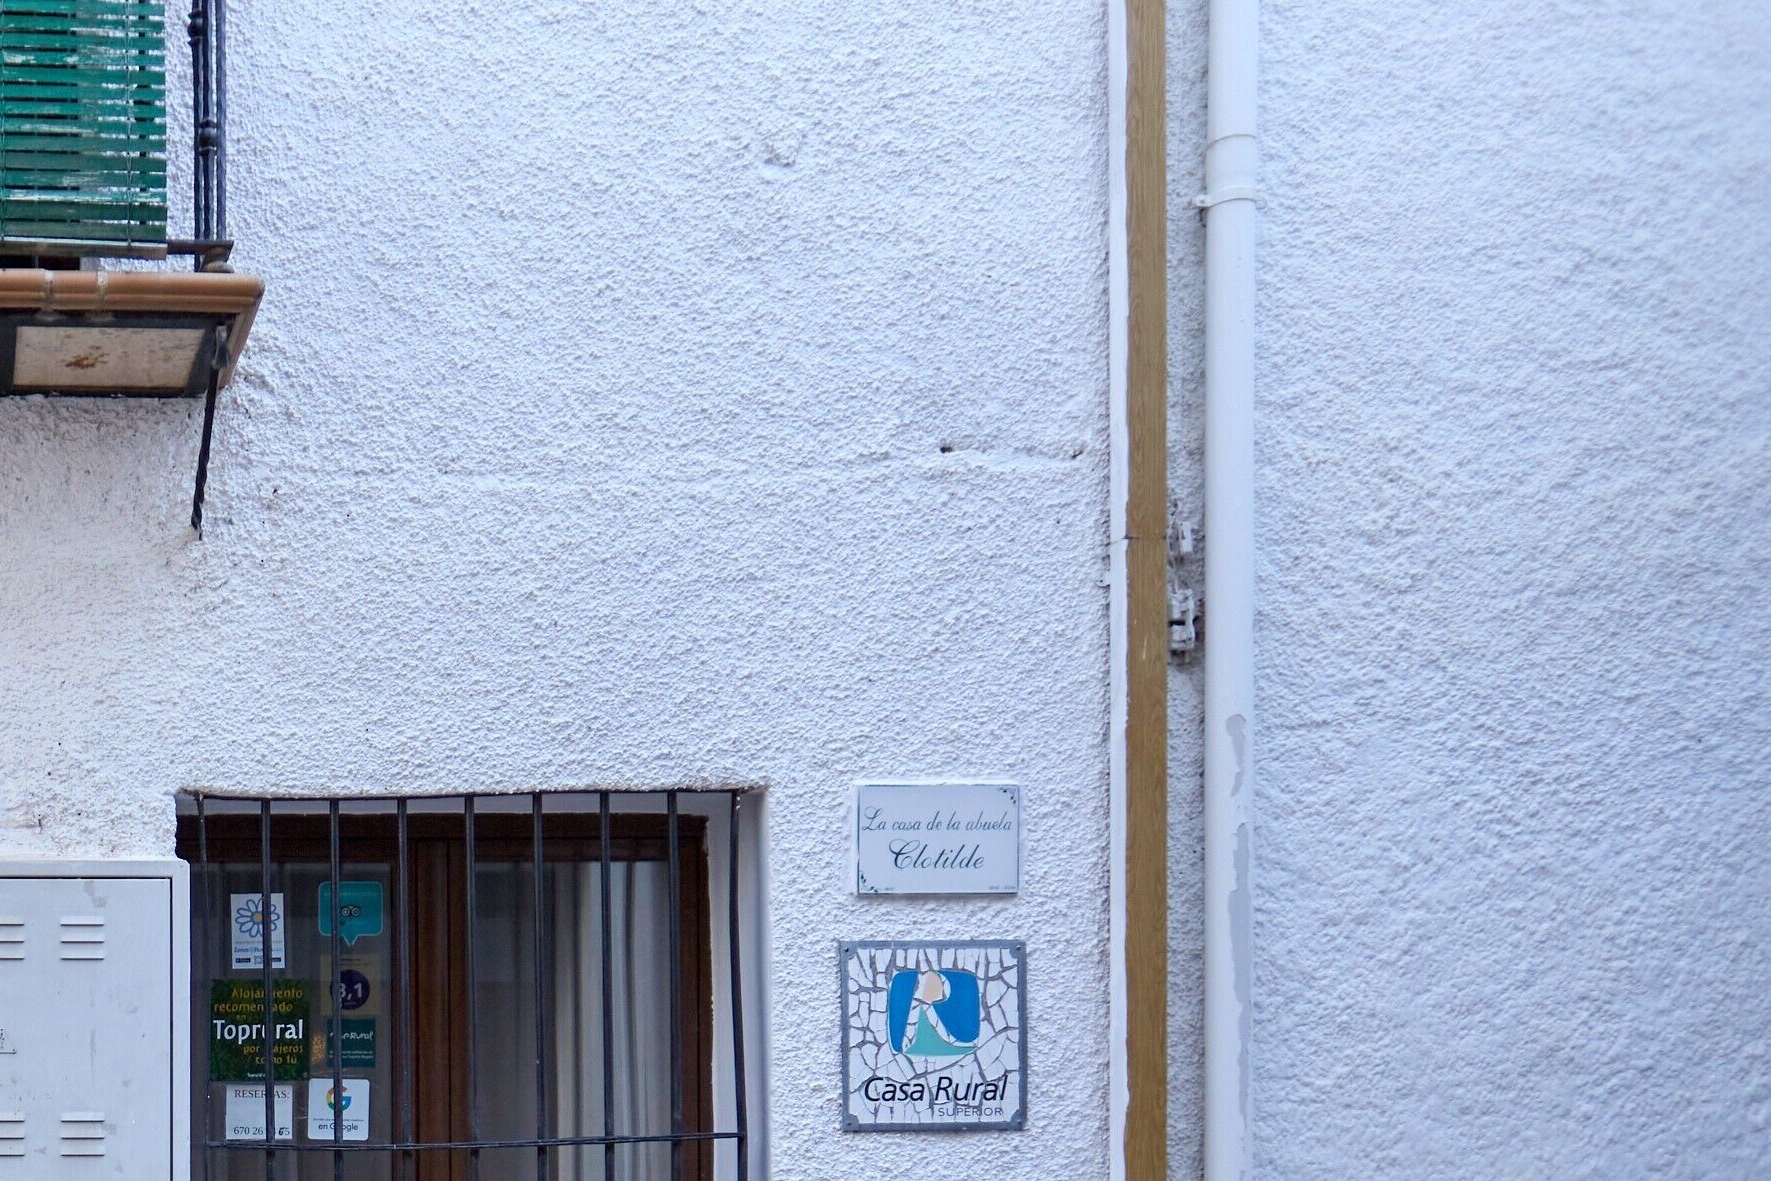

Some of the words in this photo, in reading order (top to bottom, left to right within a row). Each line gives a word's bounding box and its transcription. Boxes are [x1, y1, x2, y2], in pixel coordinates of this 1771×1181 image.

[862, 806, 886, 831] La
[891, 821, 921, 831] casa
[926, 810, 943, 831] de
[946, 810, 961, 831] la
[965, 810, 1012, 831] abuela
[888, 838, 985, 870] Clotilde
[213, 1002, 293, 1013] recomenado
[269, 1045, 304, 1055] ajeros
[864, 1077, 925, 1102] Casa
[934, 1074, 1008, 1102] Rural
[234, 1089, 290, 1100] RESERAS:
[938, 1107, 1003, 1117] SUPERIOR
[233, 1126, 250, 1136] 670
[252, 1126, 264, 1136] 26
[318, 1123, 328, 1131] en
[329, 1122, 359, 1133] Gogle
